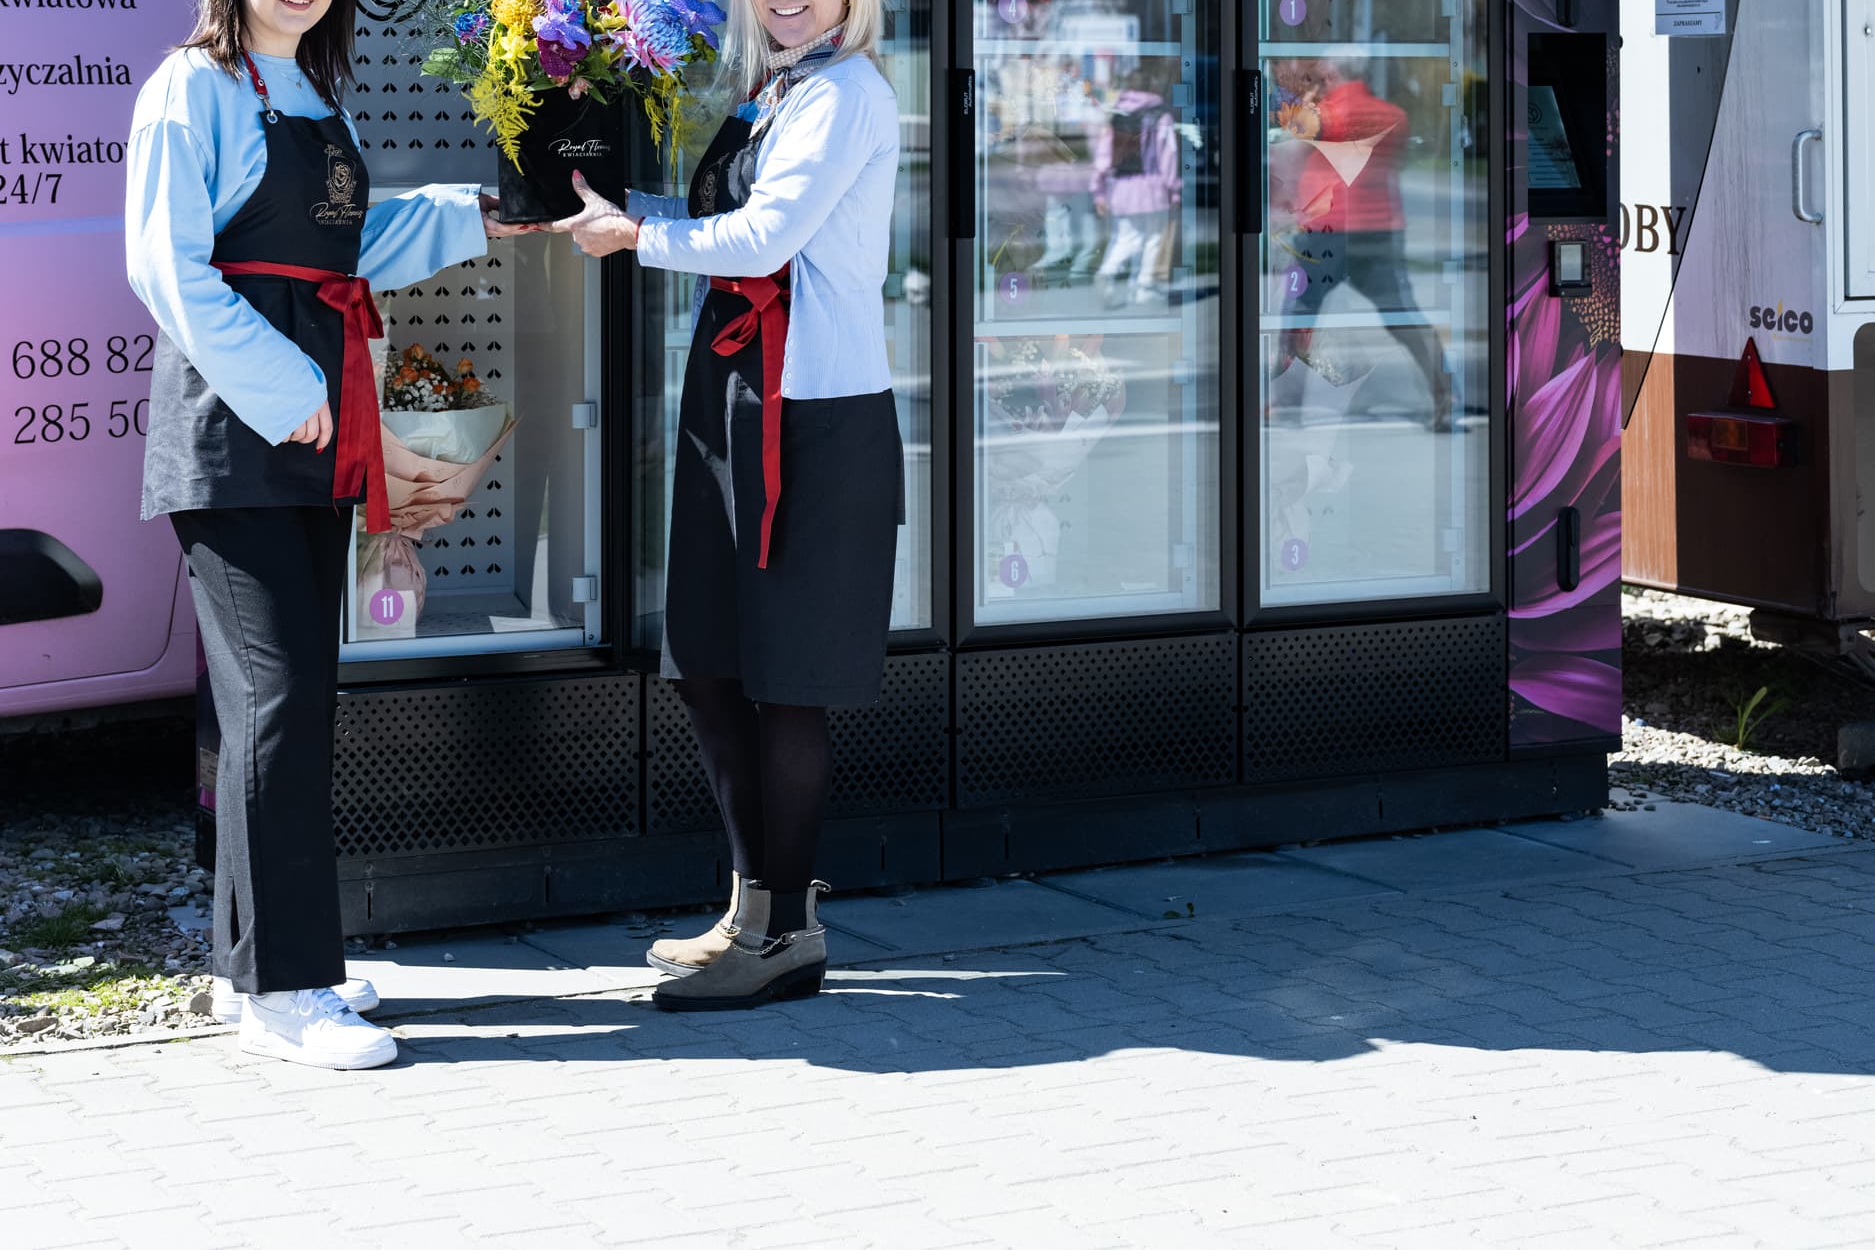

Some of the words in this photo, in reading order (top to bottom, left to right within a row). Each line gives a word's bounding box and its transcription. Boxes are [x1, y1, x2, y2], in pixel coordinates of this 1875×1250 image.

[1289, 0, 1296, 20] 1
[20, 132, 128, 164] kwiato
[1009, 278, 1018, 299] 5
[1290, 271, 1298, 292] 2
[12, 338, 91, 379] 688
[14, 402, 91, 444] 285
[1291, 544, 1299, 565] 3
[1010, 560, 1019, 582] 6
[381, 594, 394, 618] 11
